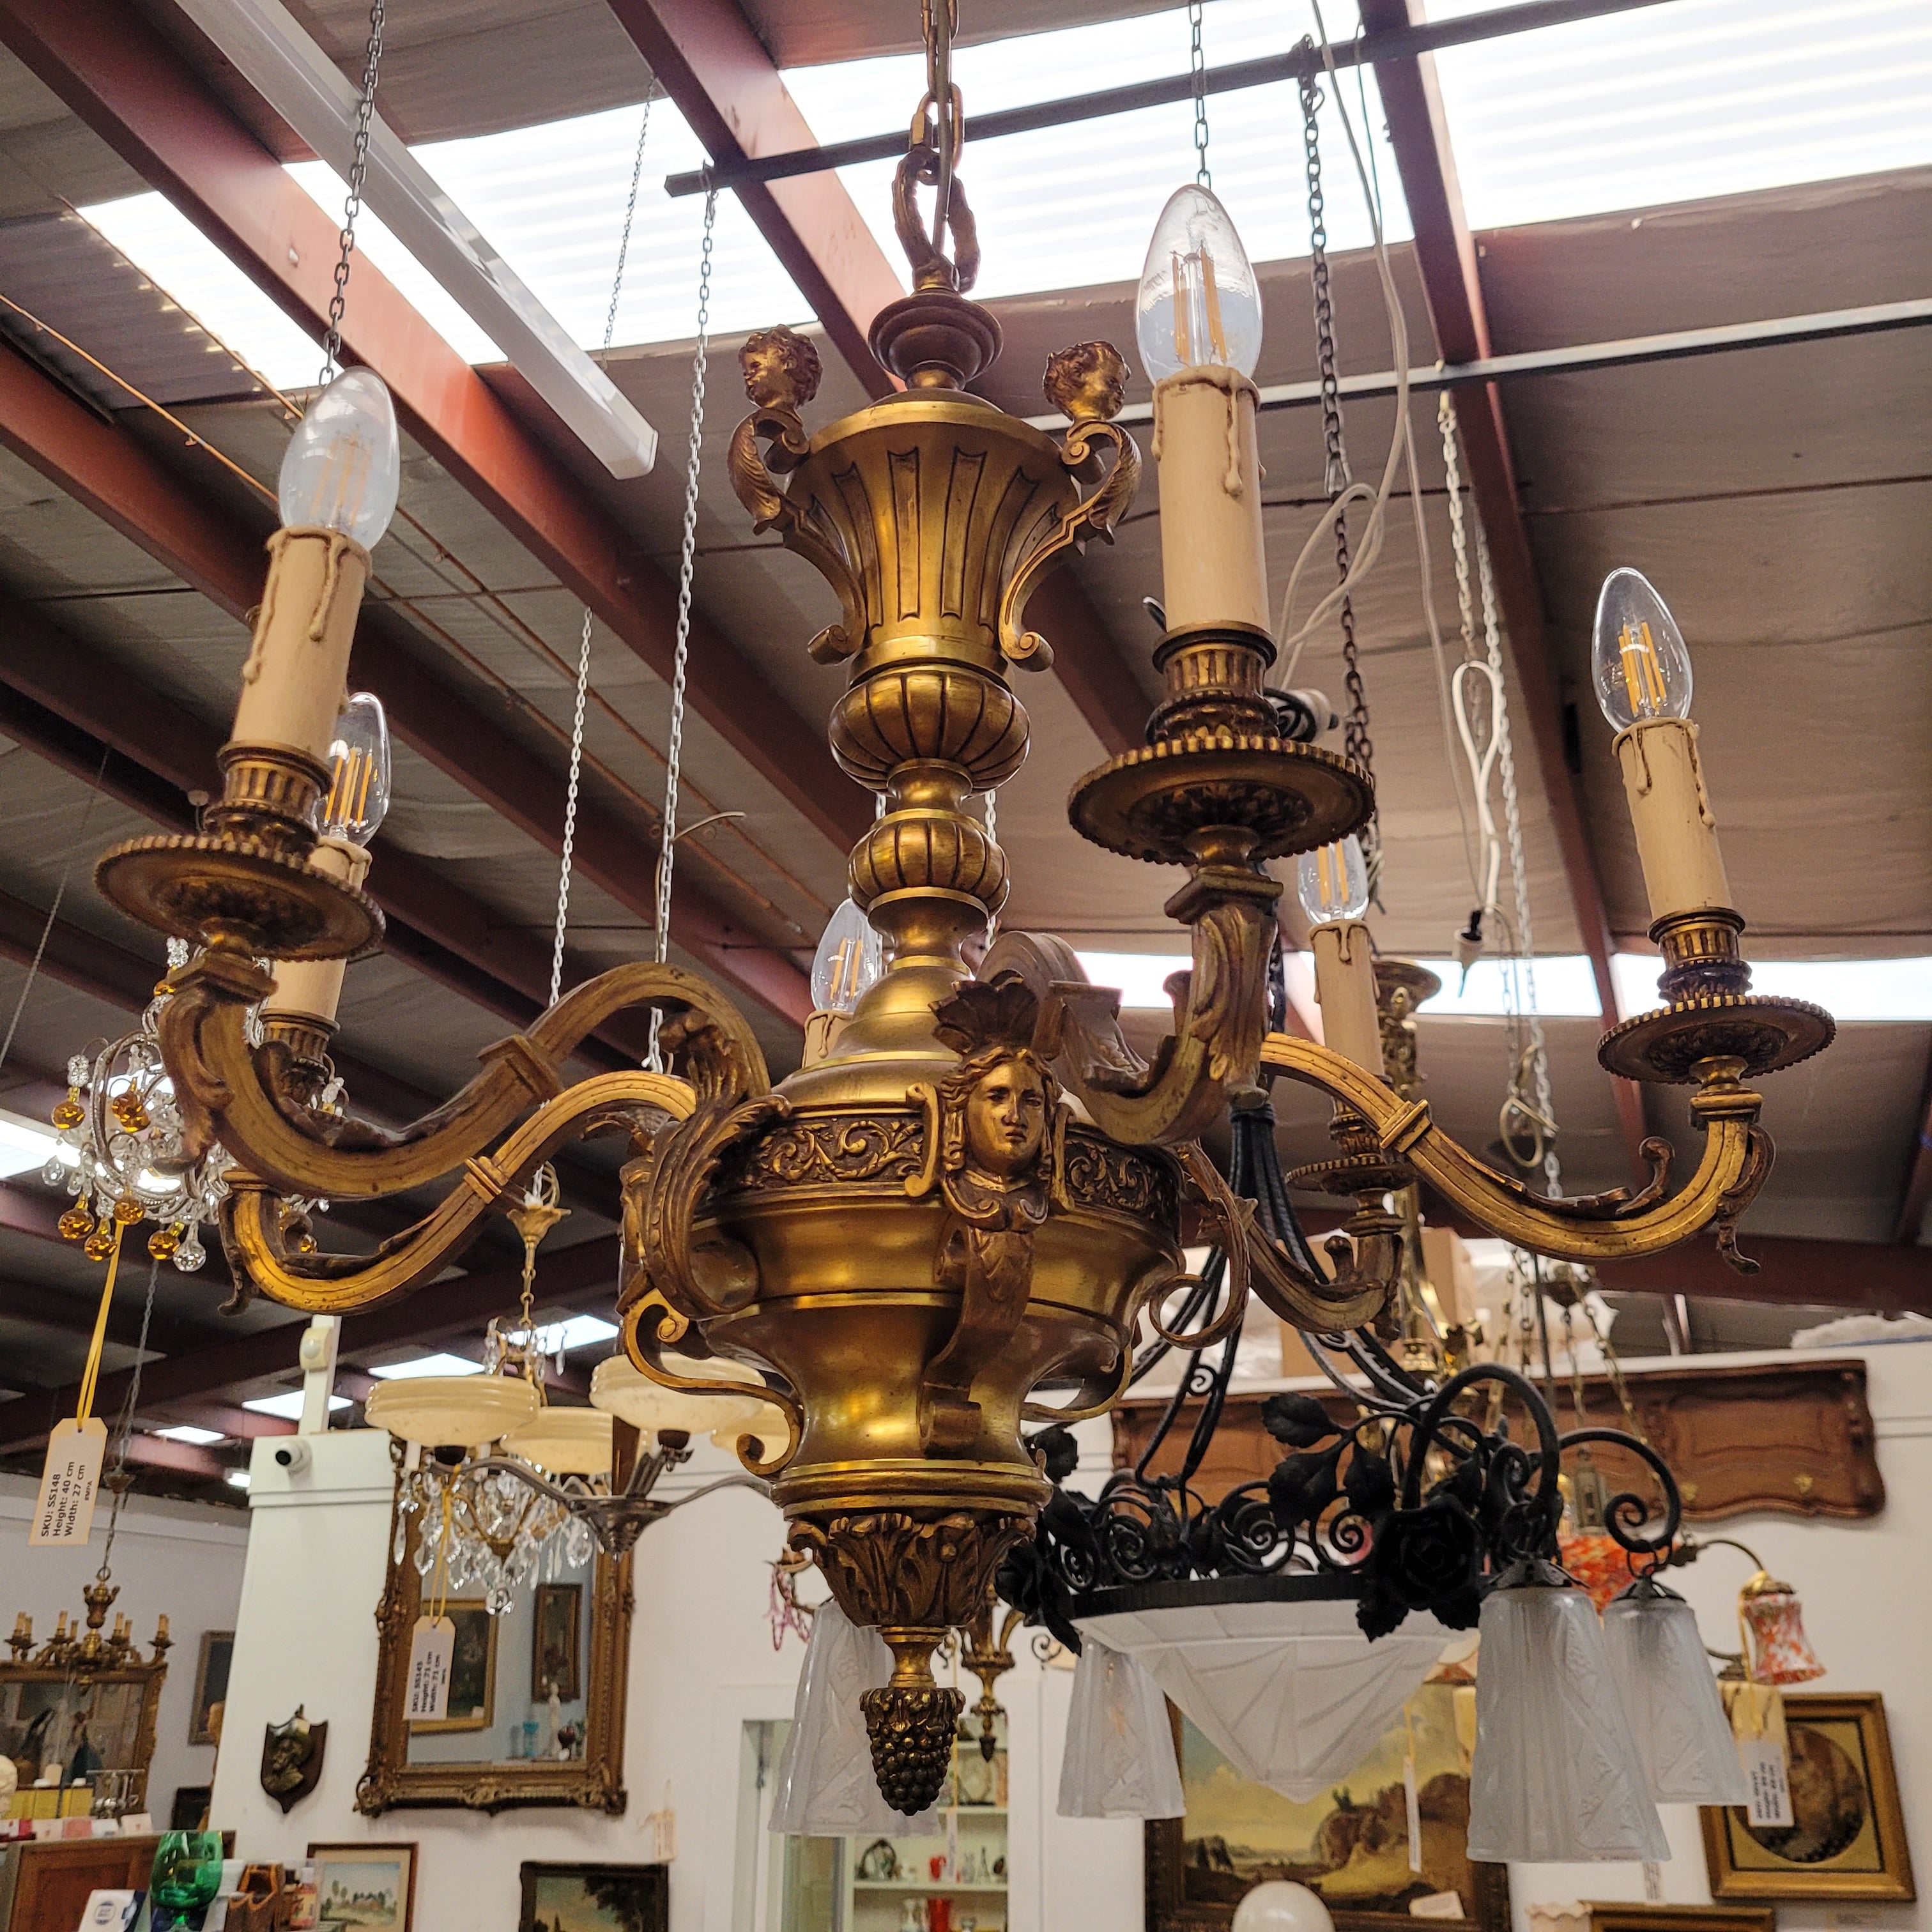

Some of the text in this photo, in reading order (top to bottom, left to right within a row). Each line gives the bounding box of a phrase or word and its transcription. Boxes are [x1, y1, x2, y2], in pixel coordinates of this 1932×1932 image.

[41, 1474, 61, 1537] SKU: SS148
[52, 1461, 75, 1537] Height: 40 cm
[64, 1464, 86, 1537] Width: 27 cm
